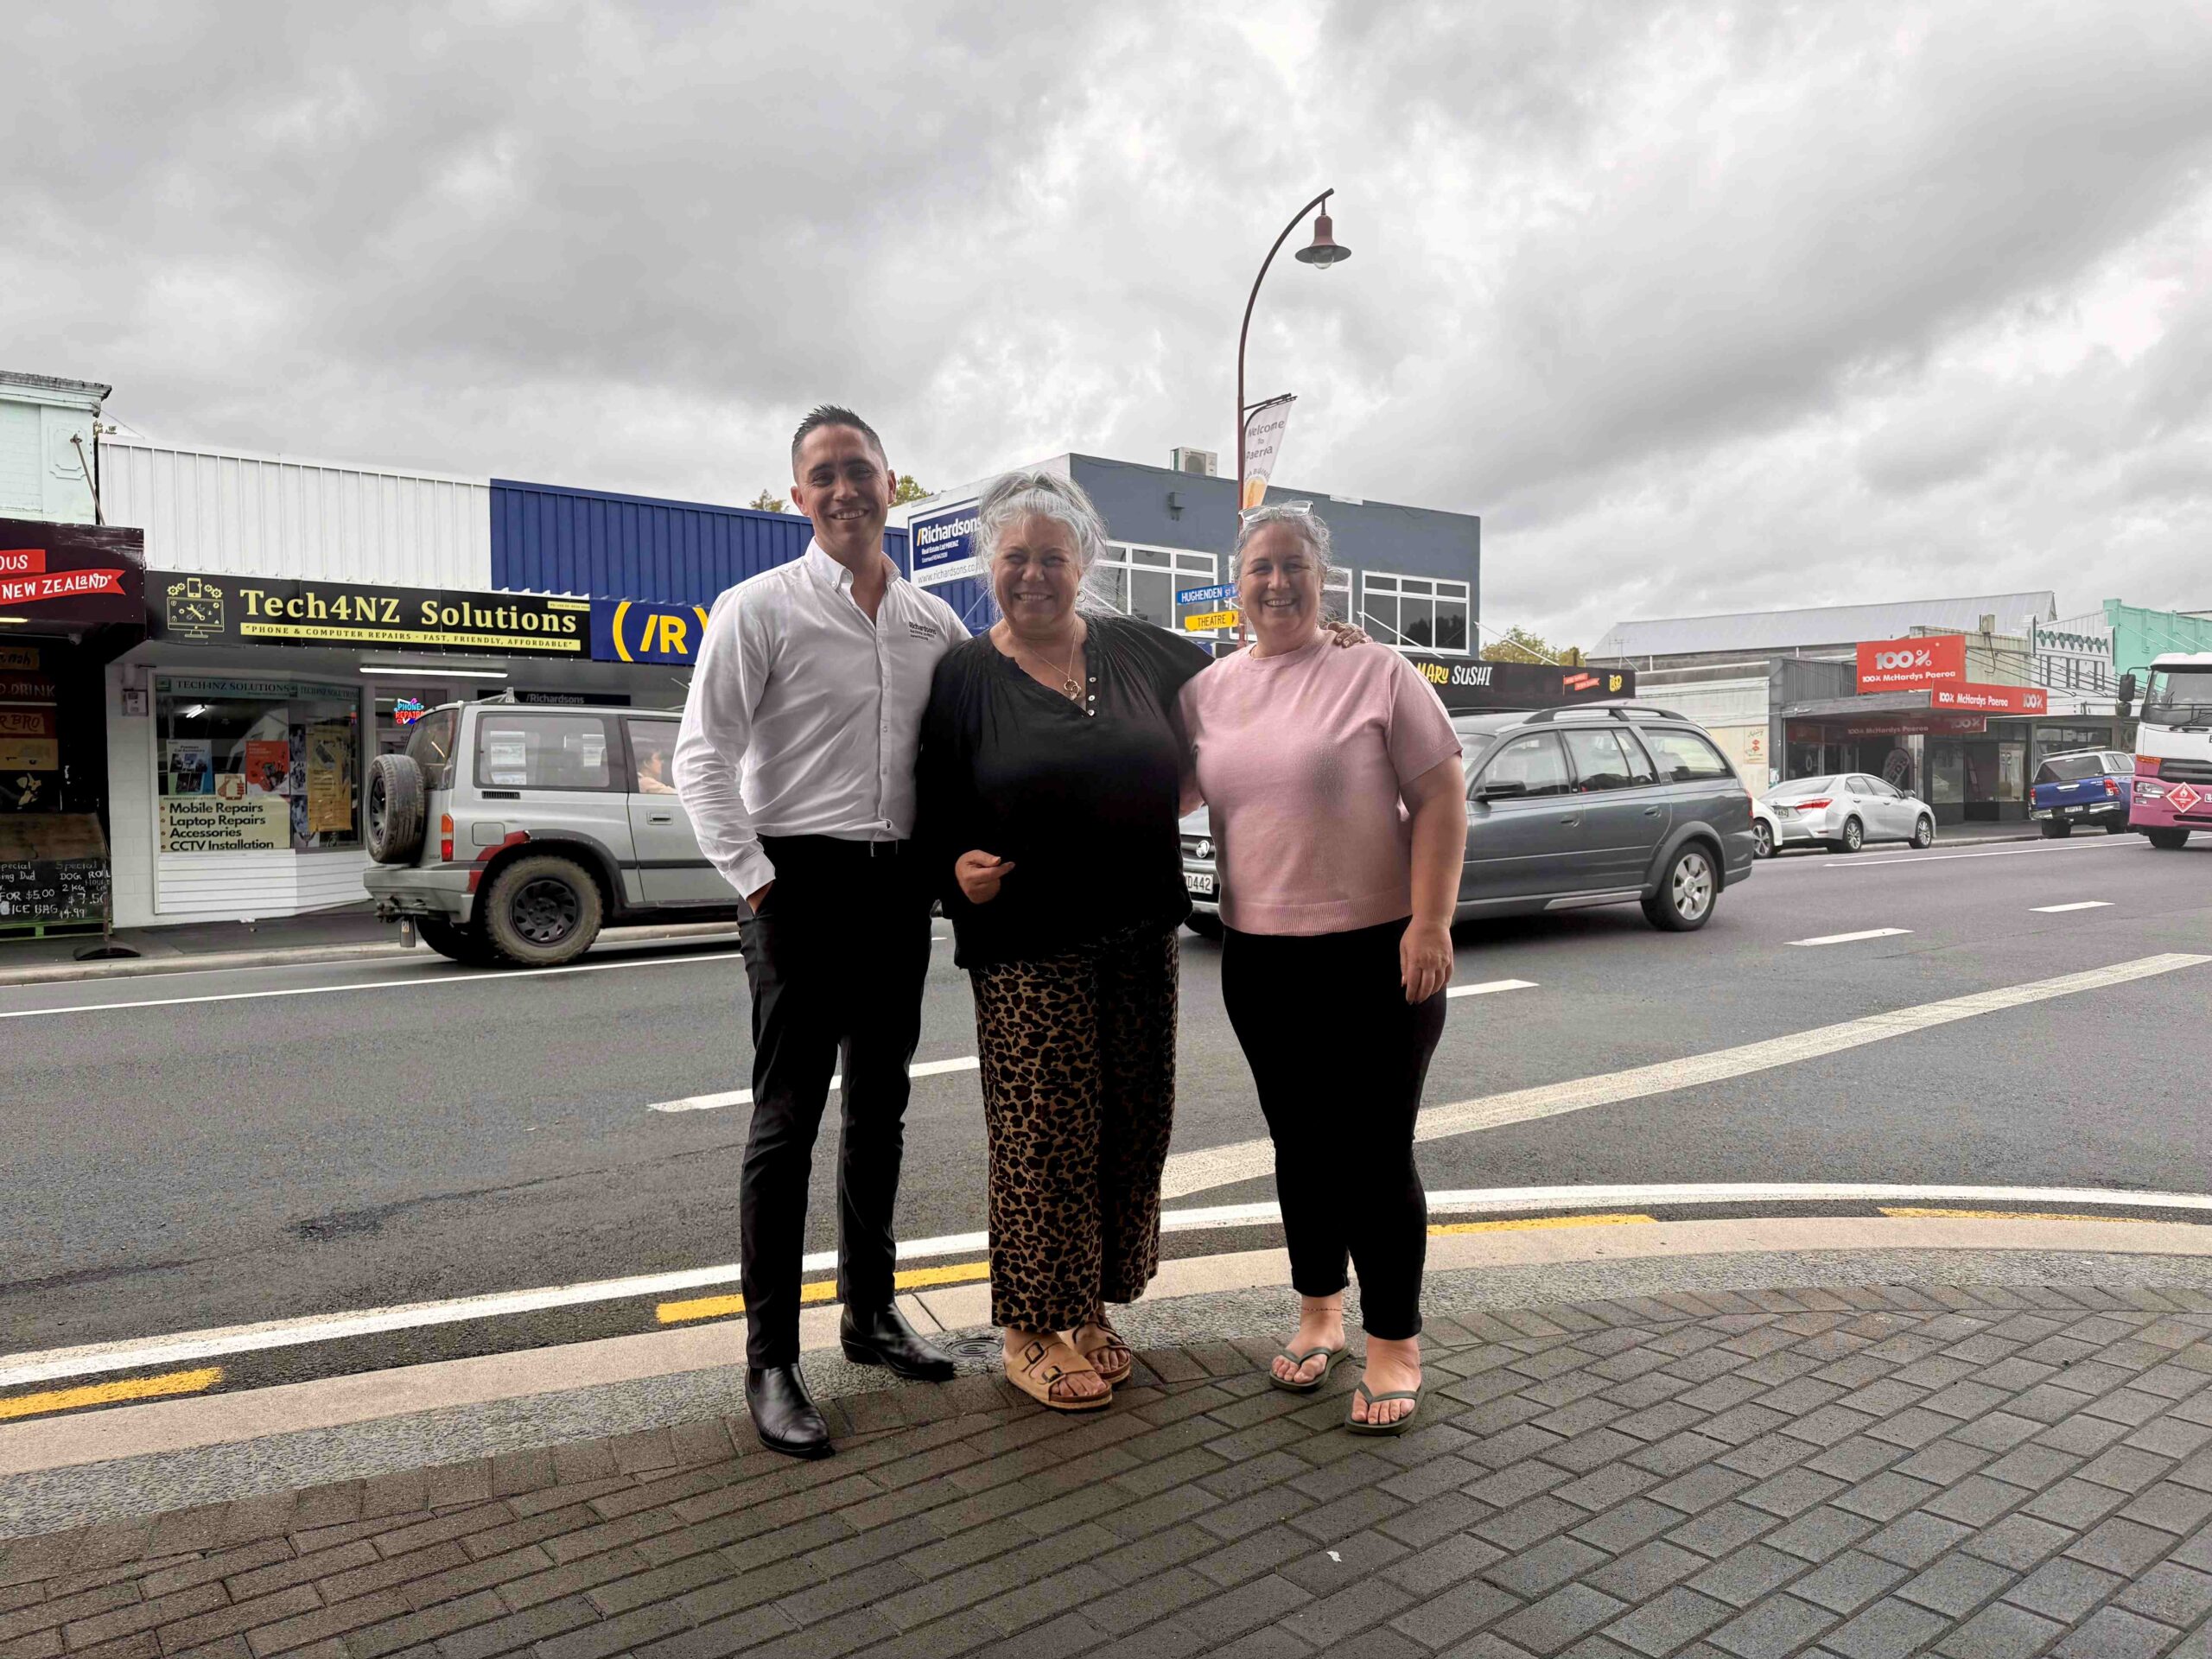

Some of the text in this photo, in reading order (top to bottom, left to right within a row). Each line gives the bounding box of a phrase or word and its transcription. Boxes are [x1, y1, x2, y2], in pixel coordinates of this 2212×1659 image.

[1247, 420, 1285, 437] Welcome
[2, 573, 108, 600] NEW ZEALAND
[1181, 587, 1223, 602] HUGHENDEN
[239, 589, 576, 633] Tech4NZ Solutions
[1198, 614, 1226, 626] THEATRE
[306, 627, 364, 639] COMPUTER
[368, 631, 411, 640] REPAIRS
[454, 635, 504, 645] FRIENDLY,
[1875, 649, 1932, 671] 100%
[1452, 664, 1492, 686] SUSHI
[1883, 671, 1923, 683] McHardys
[1925, 670, 1956, 679] Paeroa
[11, 683, 55, 696] DRINK
[230, 681, 289, 692] SOLUTIONS
[1939, 691, 2009, 708] 100% McHardys Paeroa
[2023, 693, 2044, 709] 100%
[397, 702, 421, 711] PHONE
[11, 715, 40, 732] BRO
[169, 802, 264, 815] Mobile Repairs
[169, 815, 266, 829] Laptop Repairs
[169, 827, 242, 838] Accessories
[170, 839, 274, 851] CCTV Installation
[0, 861, 31, 872] pecial
[60, 872, 82, 880] DOG
[25, 889, 55, 900] $5.00
[12, 904, 30, 915] ICE
